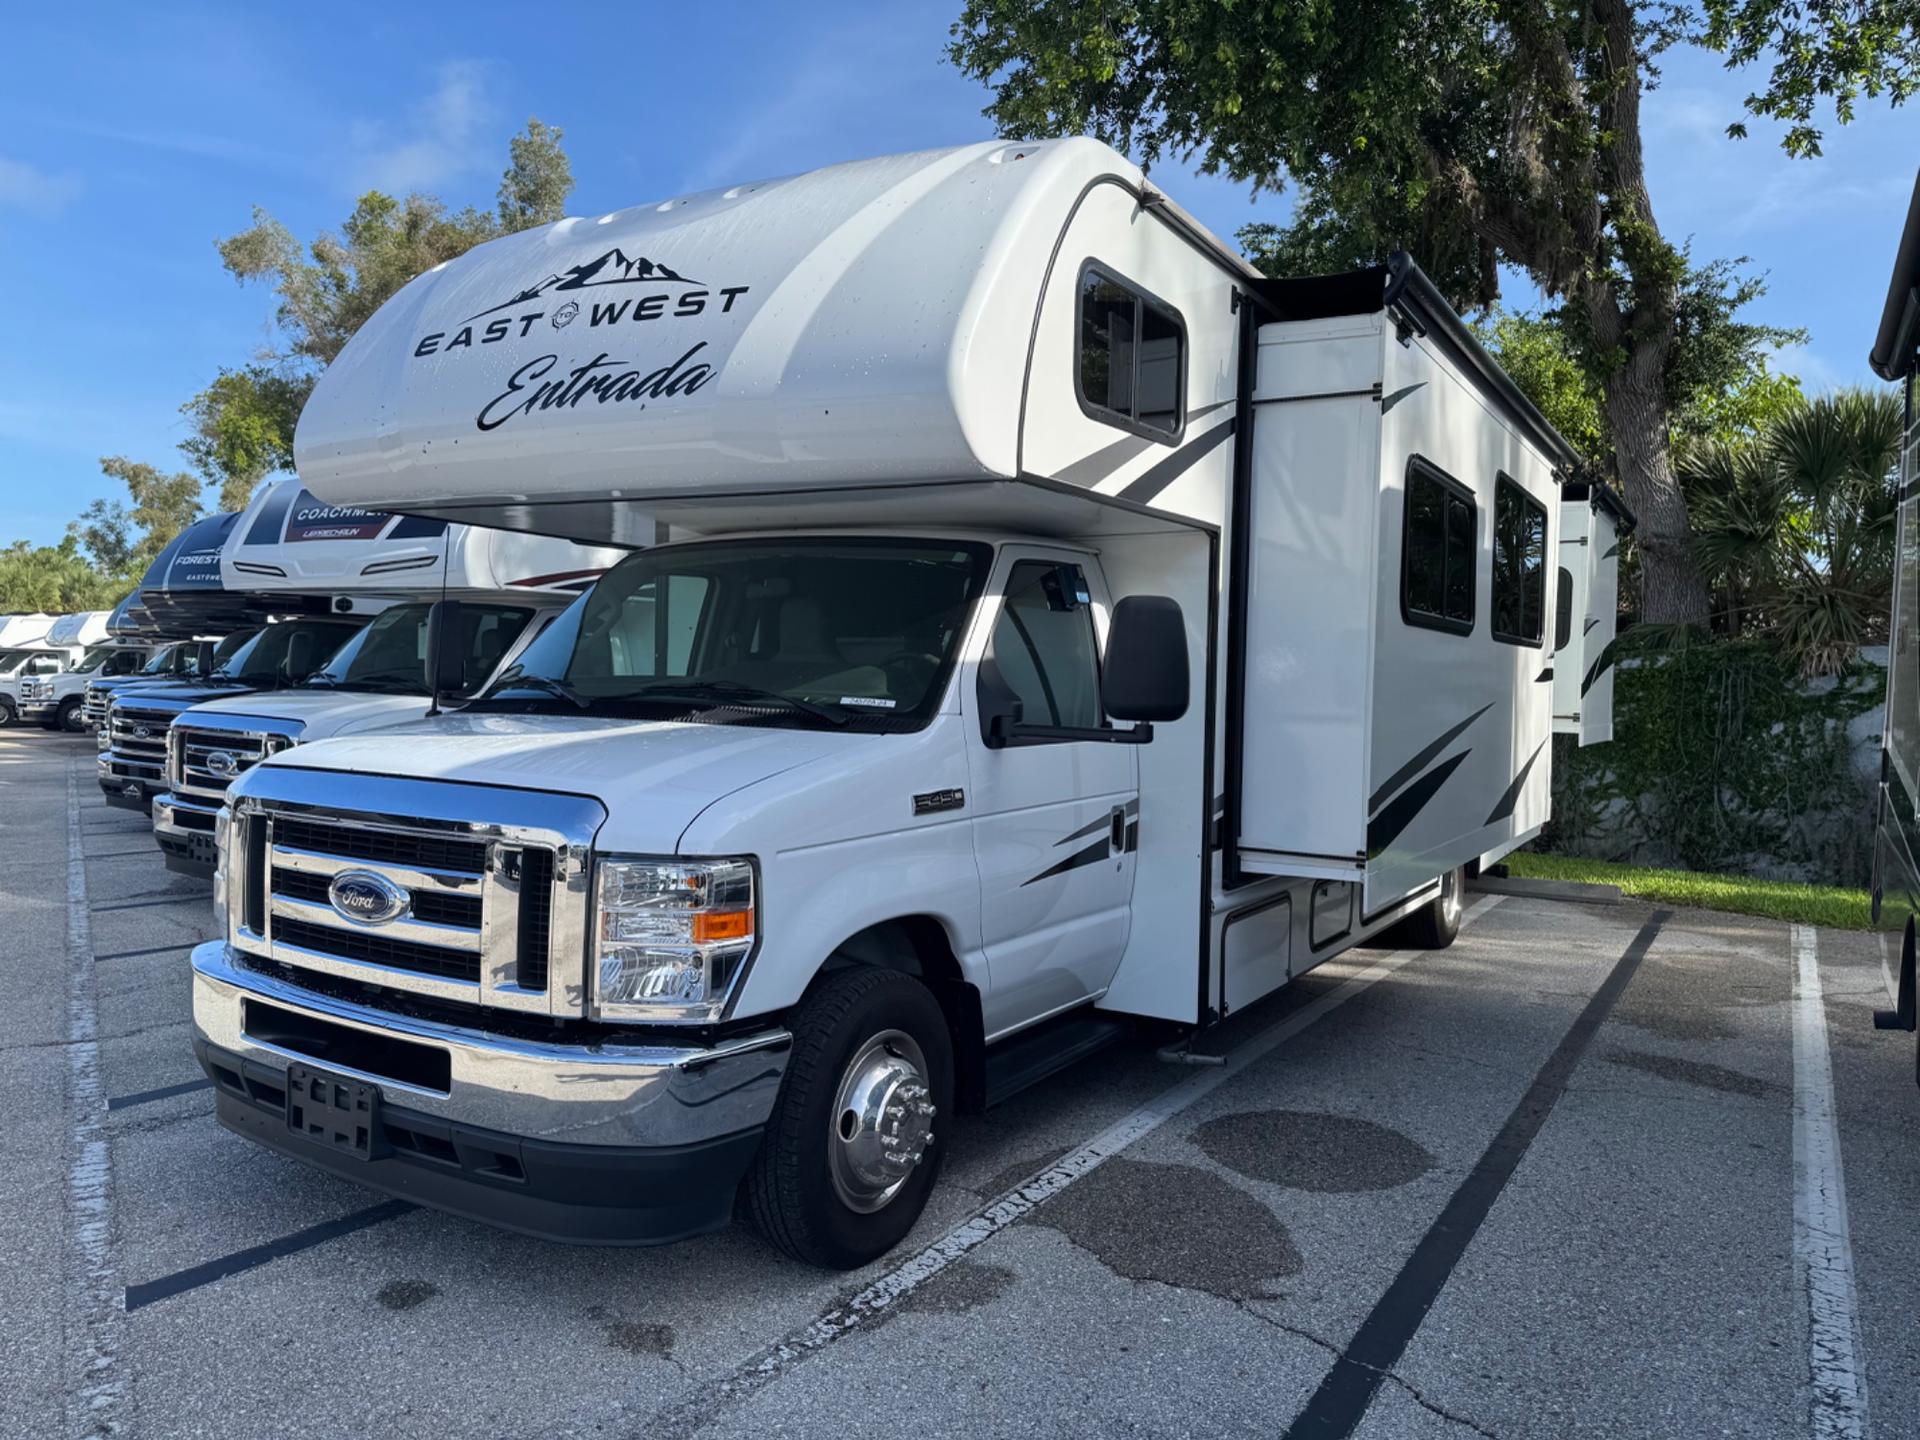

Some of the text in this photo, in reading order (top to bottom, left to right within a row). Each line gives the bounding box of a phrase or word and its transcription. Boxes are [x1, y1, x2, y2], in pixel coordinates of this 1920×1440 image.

[414, 312, 544, 357] EAST
[589, 286, 750, 327] WEST
[477, 341, 718, 431] Entrada
[297, 507, 388, 520] COACHM
[175, 555, 221, 565] FOREST
[342, 884, 375, 909] Ford
